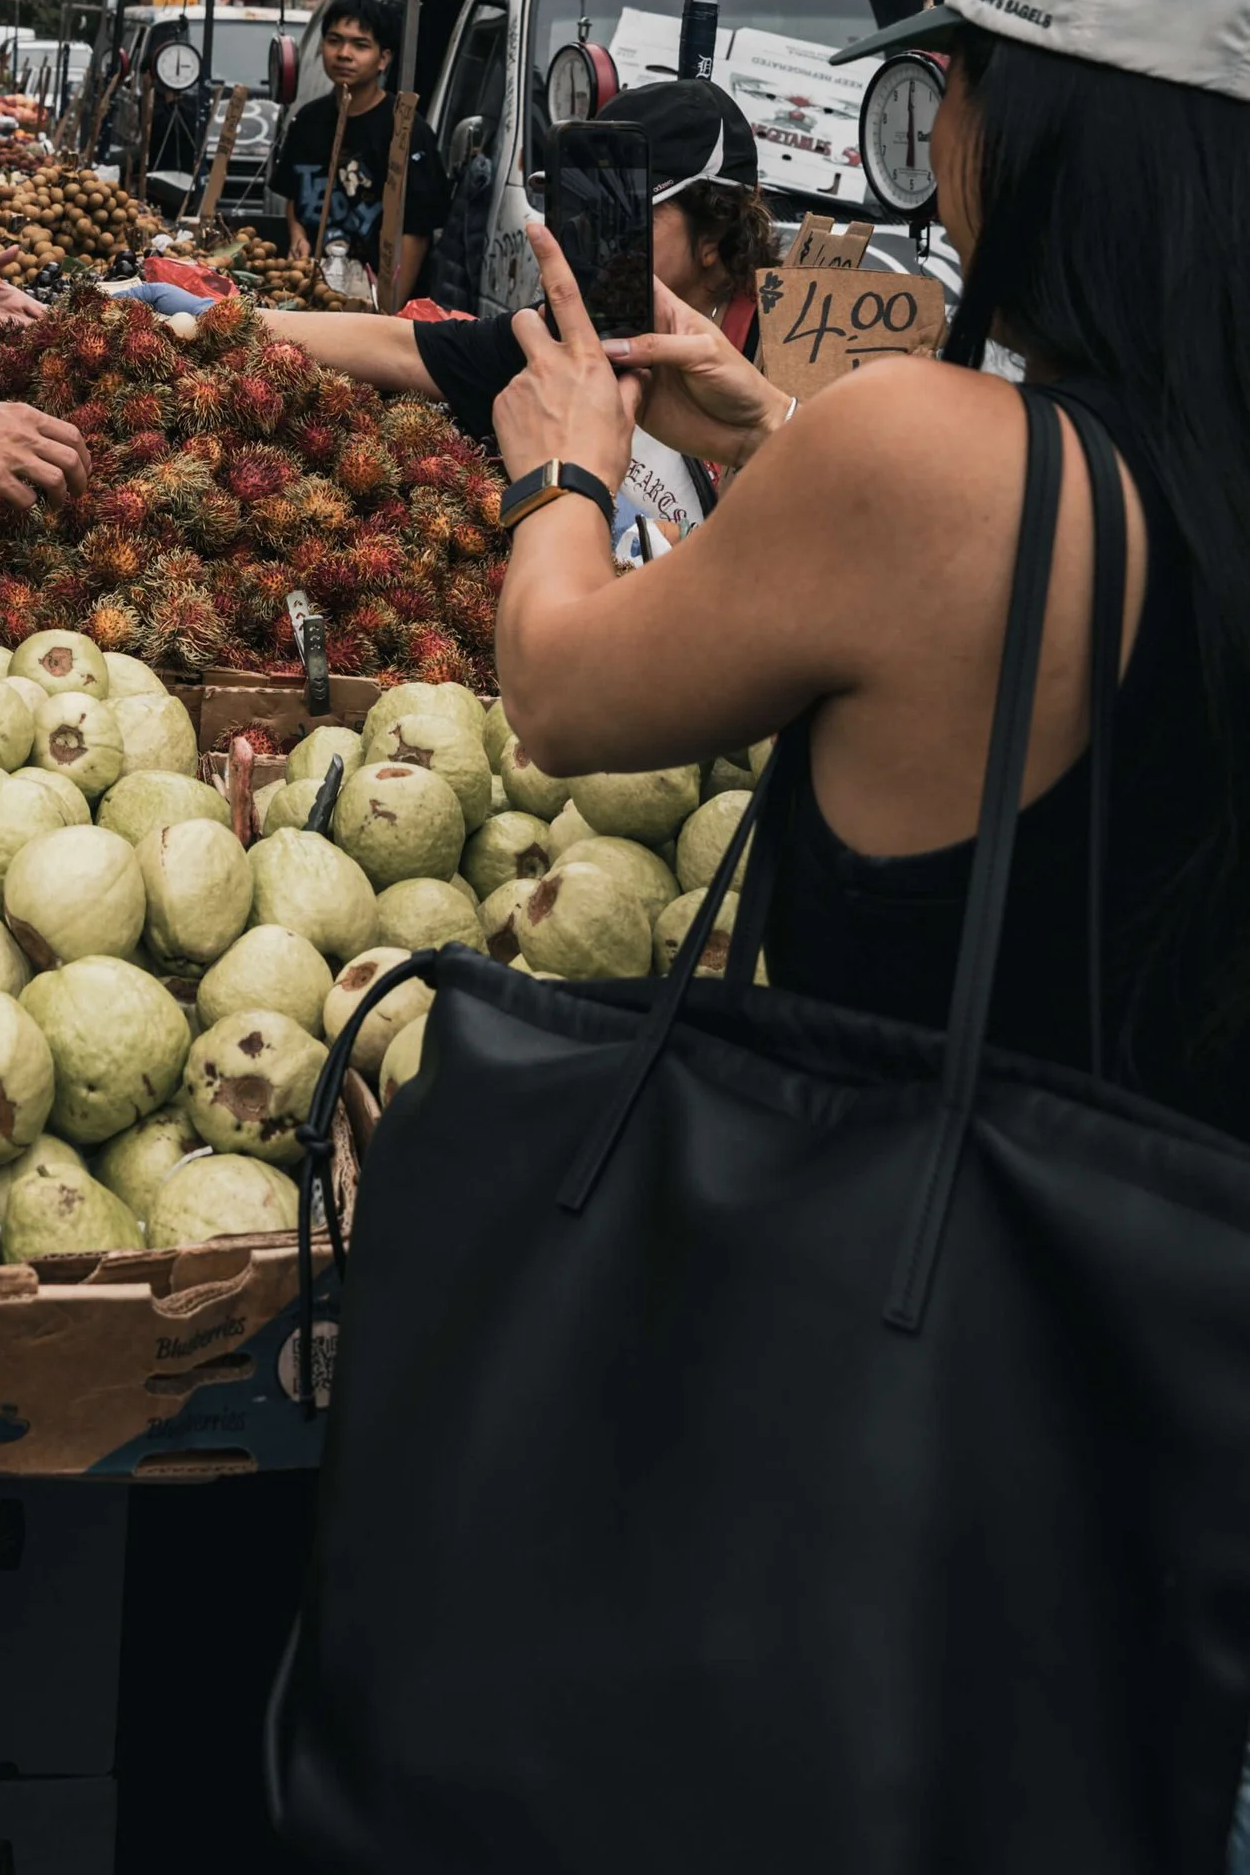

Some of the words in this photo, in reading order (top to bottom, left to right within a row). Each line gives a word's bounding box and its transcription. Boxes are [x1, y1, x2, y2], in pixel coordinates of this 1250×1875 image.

[1004, 0, 1054, 29] BAGELS
[624, 458, 687, 524] EARTS
[155, 1315, 248, 1360] Blueberries
